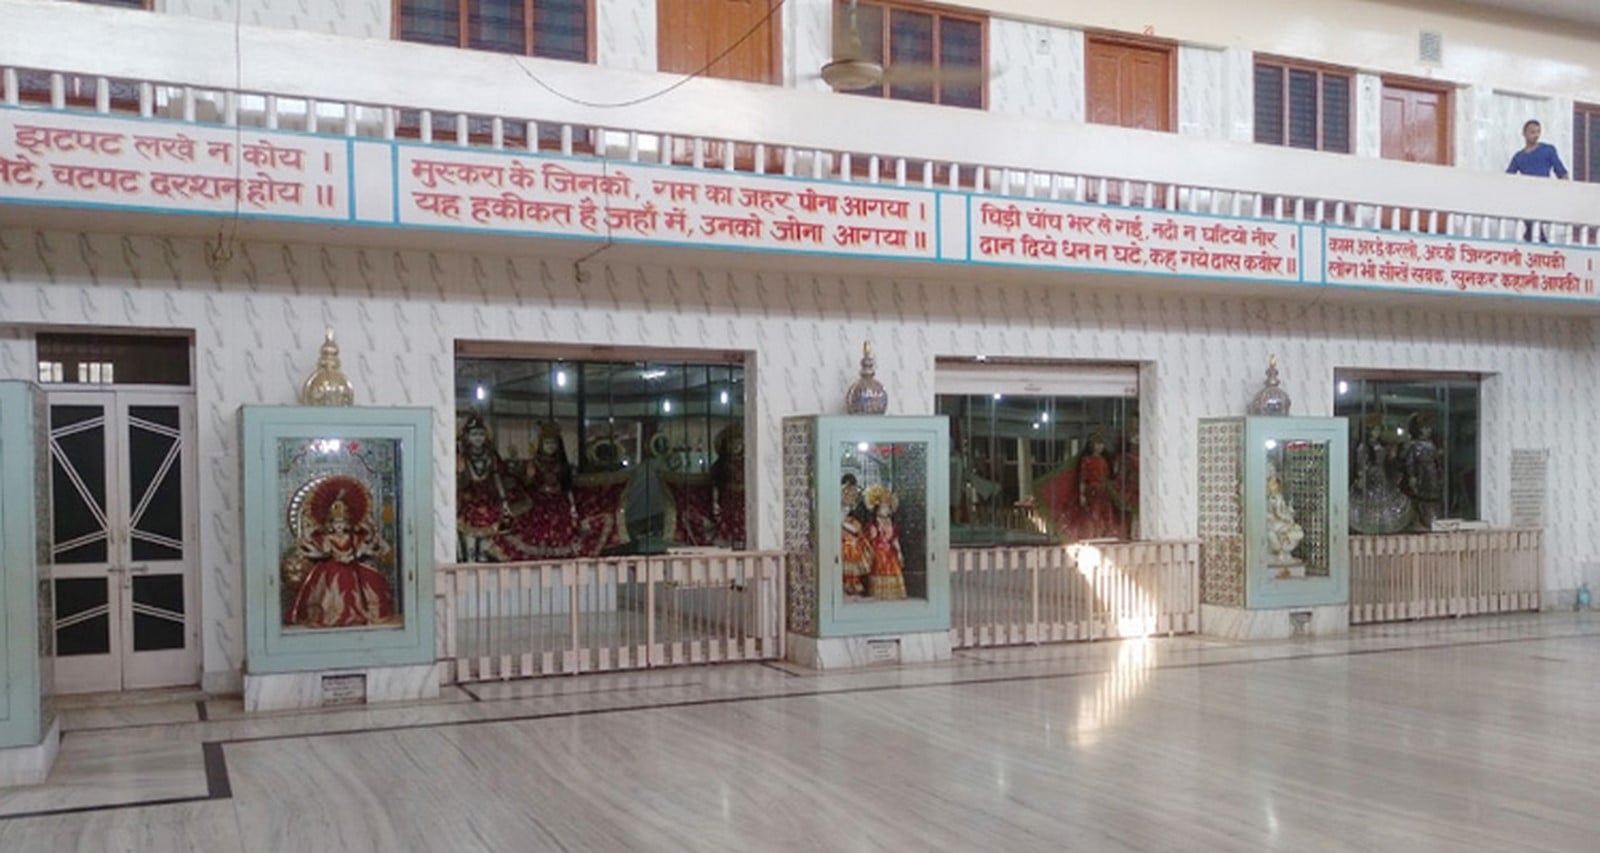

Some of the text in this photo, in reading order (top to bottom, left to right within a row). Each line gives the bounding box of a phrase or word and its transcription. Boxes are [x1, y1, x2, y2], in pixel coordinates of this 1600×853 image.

[14, 124, 124, 155] झटपट
[207, 141, 232, 163] न
[242, 140, 304, 170] कोय
[50, 163, 141, 193] चटपट
[246, 171, 302, 207] होय
[508, 160, 535, 188] के
[704, 184, 733, 206] का
[738, 188, 796, 215] जहर
[412, 191, 462, 220] यह
[470, 192, 573, 224] हकीकत
[579, 197, 599, 232] है
[699, 213, 764, 238] उनको
[1184, 224, 1197, 243] न
[979, 235, 1016, 256] दान
[1094, 244, 1108, 261] न
